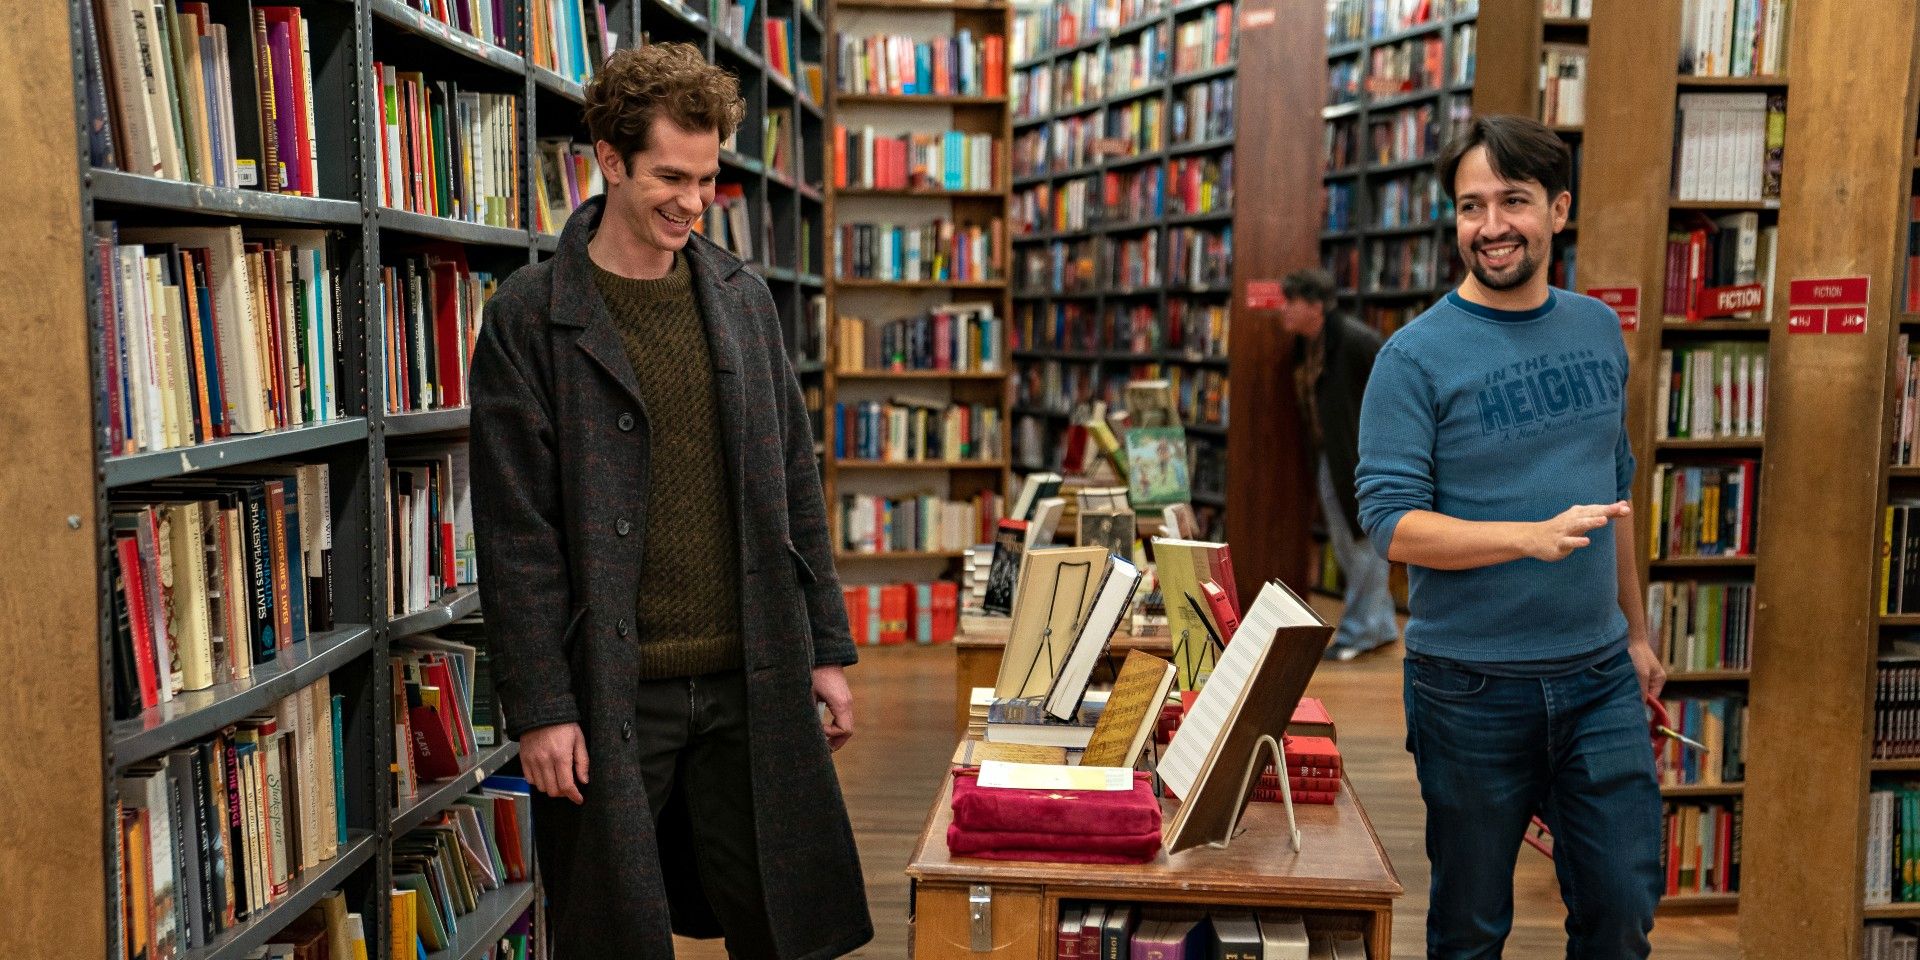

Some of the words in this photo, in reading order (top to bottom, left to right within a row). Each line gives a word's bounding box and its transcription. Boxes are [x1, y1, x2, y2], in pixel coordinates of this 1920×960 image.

[1718, 287, 1761, 310] FICTION
[1813, 285, 1842, 298] FICTION
[1484, 368, 1506, 386] IN
[1511, 354, 1549, 375] THE
[1477, 359, 1621, 437] HEIGHTS
[322, 469, 330, 520] CONTESTED
[250, 502, 264, 587] SHAKESPEARE'S
[275, 508, 287, 591] SHAKESPEARE'S
[324, 521, 333, 546] WILL
[258, 508, 273, 608] SCHOENBAUM
[256, 587, 267, 620] LIVES
[280, 593, 289, 624] LIVES
[414, 730, 431, 757] PLAYS
[227, 767, 238, 790] THE
[230, 792, 240, 828] STAGE
[266, 772, 284, 845] Shakespeare
[199, 819, 209, 851] LEAR
